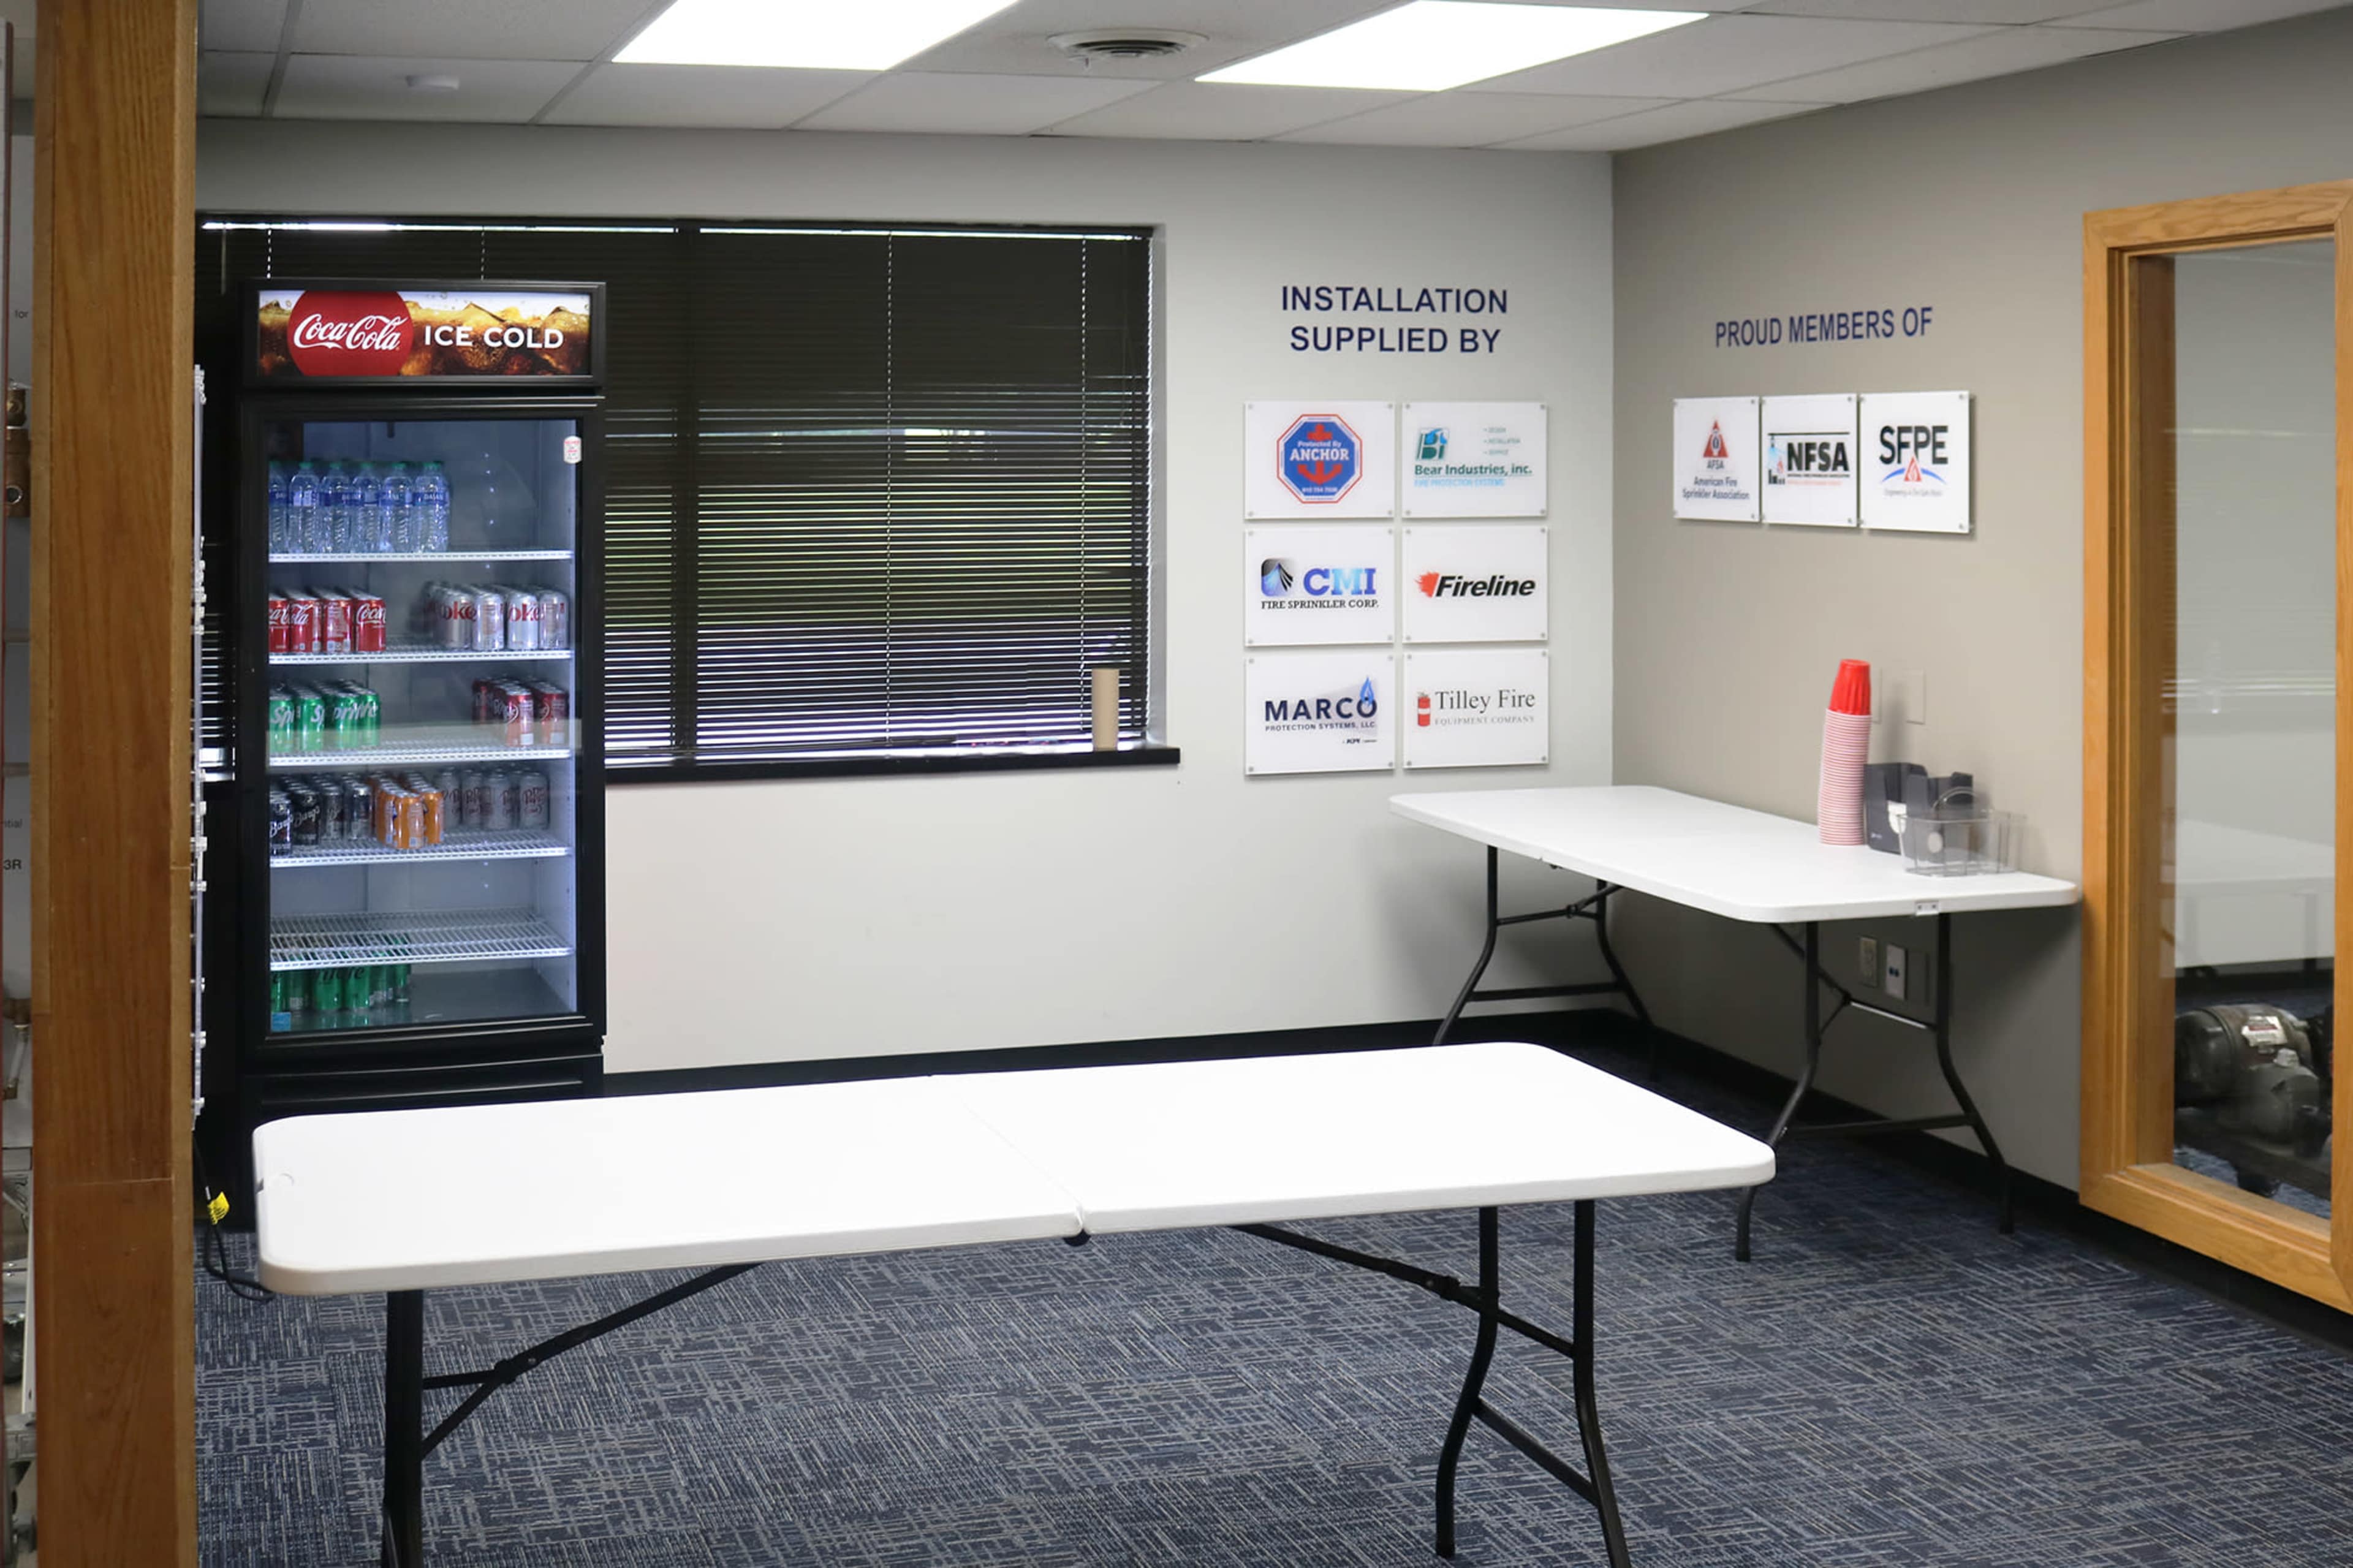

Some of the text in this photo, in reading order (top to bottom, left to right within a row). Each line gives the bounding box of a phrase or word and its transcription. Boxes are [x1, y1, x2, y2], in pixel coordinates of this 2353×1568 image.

[1281, 286, 1507, 314] INSTALLATION
[294, 313, 564, 351] Coca-Cola ICE COLD
[1715, 306, 1933, 348] PROUD MEMBERS OF
[1290, 326, 1501, 354] SUPPLIED BY
[1289, 448, 1350, 461] ANCHOR
[1787, 441, 1850, 471] NFSA
[1879, 425, 1949, 465] SFPE
[1414, 463, 1533, 477] Bear Industries, inc.
[1707, 460, 1725, 470] AFSA
[1694, 476, 1738, 487] American Fire
[1682, 488, 1749, 501] Sprinkler Association
[1303, 567, 1377, 597] CMI
[1435, 575, 1536, 597] Fireline
[1261, 599, 1379, 610] FIRE SPRINKLER CORP.
[1265, 697, 1377, 722] MARCO
[1435, 689, 1536, 714] Tilley Fire
[1319, 722, 1359, 730] SYSTEMS,
[1434, 715, 1535, 726] EQUIPMENT COMPANY
